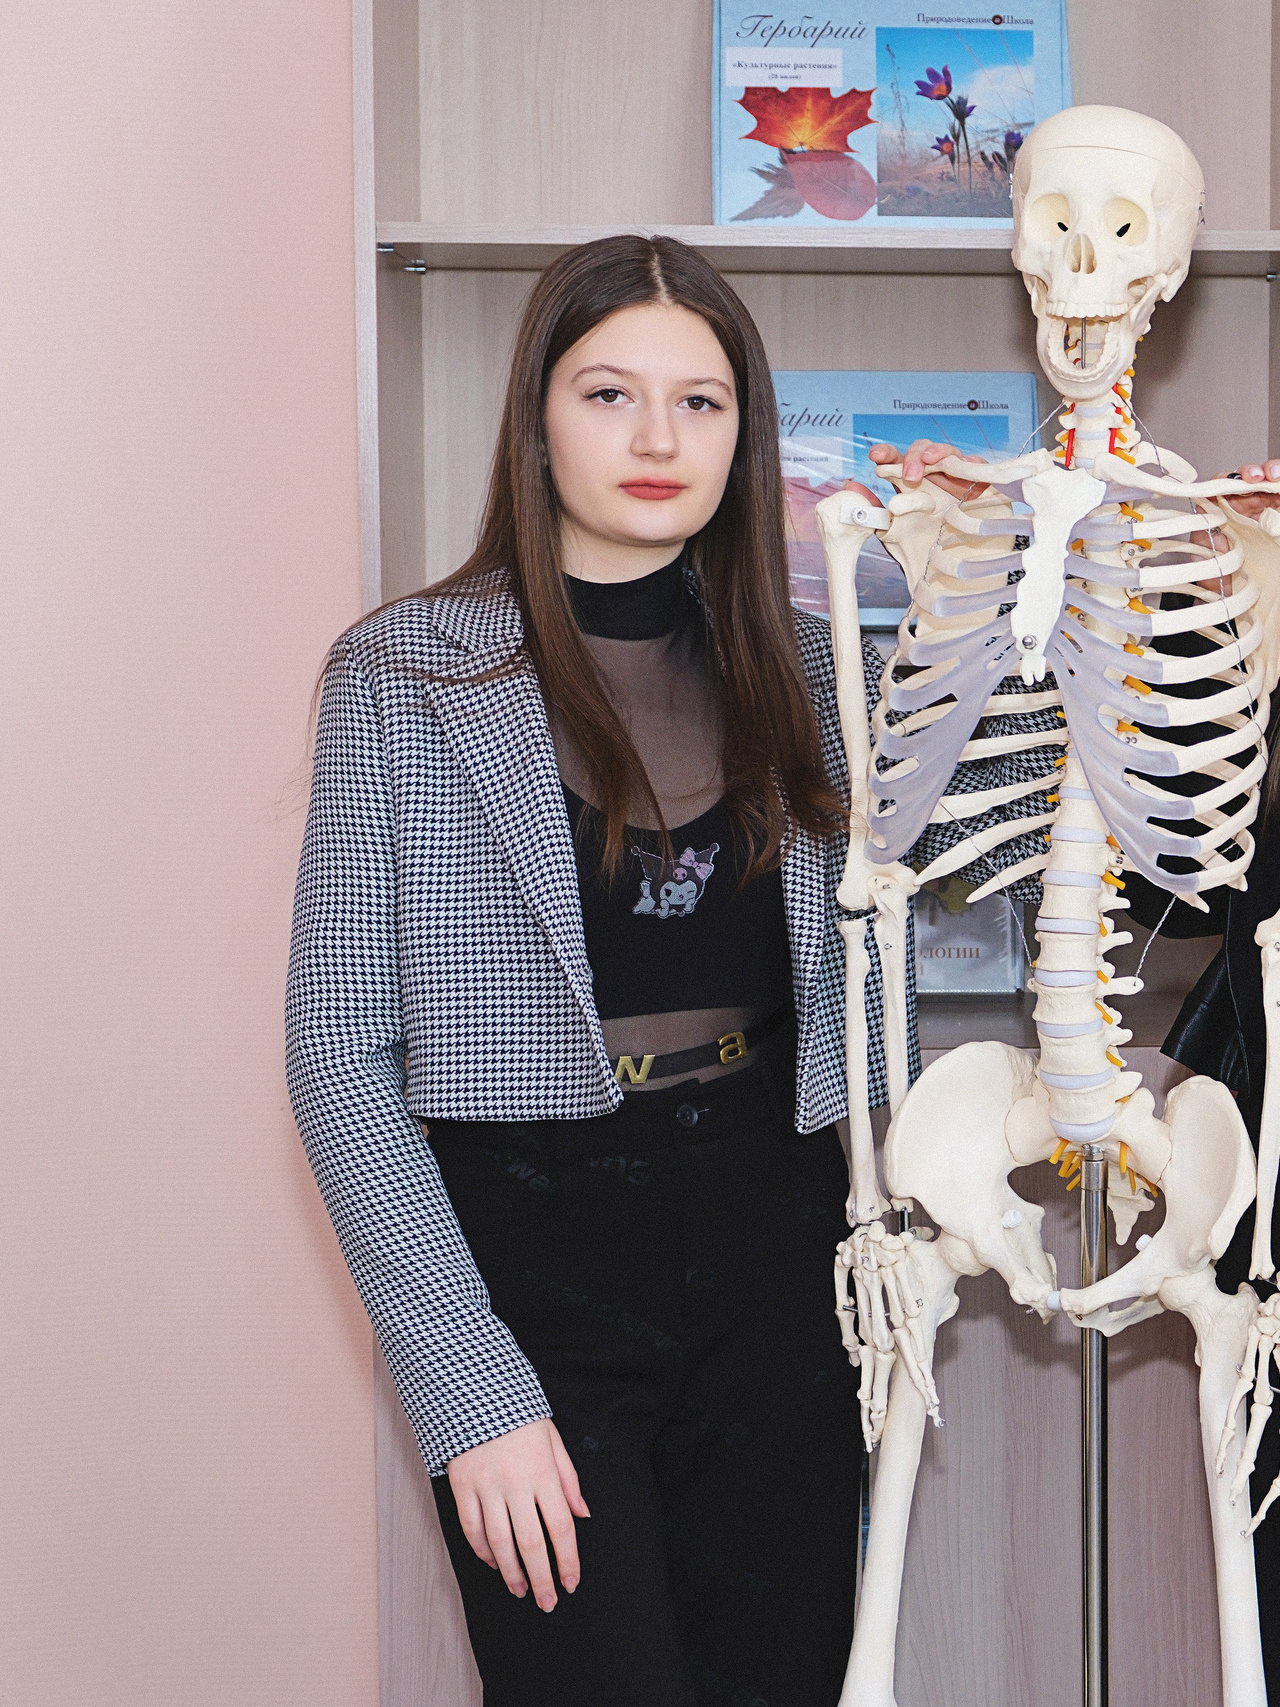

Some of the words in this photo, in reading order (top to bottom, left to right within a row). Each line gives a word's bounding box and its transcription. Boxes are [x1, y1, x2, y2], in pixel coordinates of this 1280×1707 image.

[917, 13, 991, 24] Природоведение
[1003, 15, 1034, 25] Школа
[735, 14, 868, 48] Гербарий
[893, 399, 967, 411] Природоведение
[978, 400, 1009, 410] Школа
